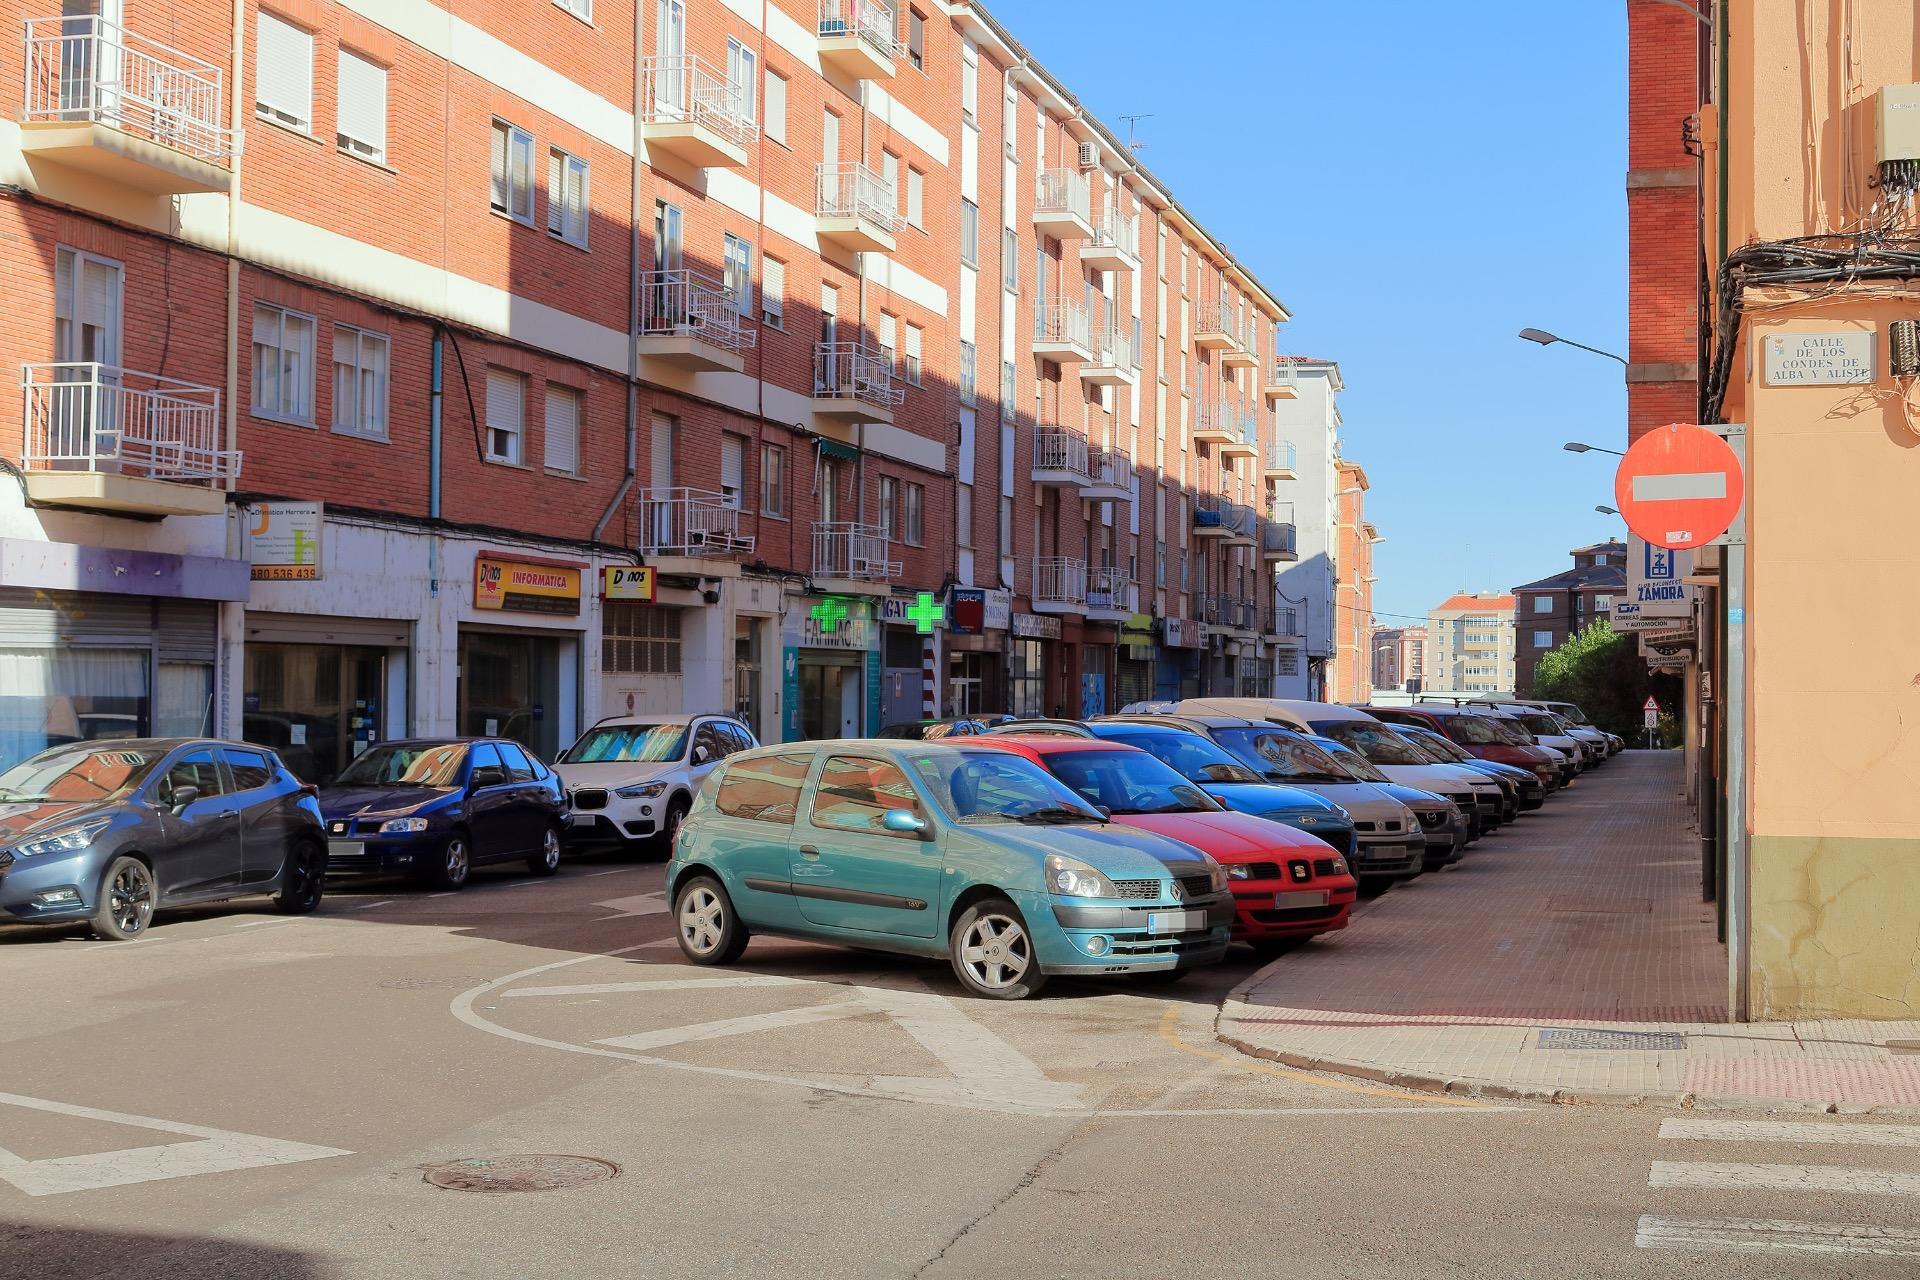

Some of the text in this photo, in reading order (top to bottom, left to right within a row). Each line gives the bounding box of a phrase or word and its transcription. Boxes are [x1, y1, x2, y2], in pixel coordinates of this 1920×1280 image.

[1803, 338, 1843, 347] CALLE
[1796, 348, 1846, 357] DE LOS
[1782, 358, 1859, 369] CONDES DE
[1773, 368, 1869, 380] ALBA Y ALISTE
[286, 507, 310, 515] Herrera
[251, 569, 270, 579] 980
[273, 569, 293, 579] 536
[512, 571, 567, 588] INFORMATICA
[1652, 578, 1683, 588] BALONCEST
[1637, 586, 1685, 601] ZAMORA
[804, 616, 863, 648] FARMACIA
[1649, 655, 1689, 663] DISTRIBUIDOR
